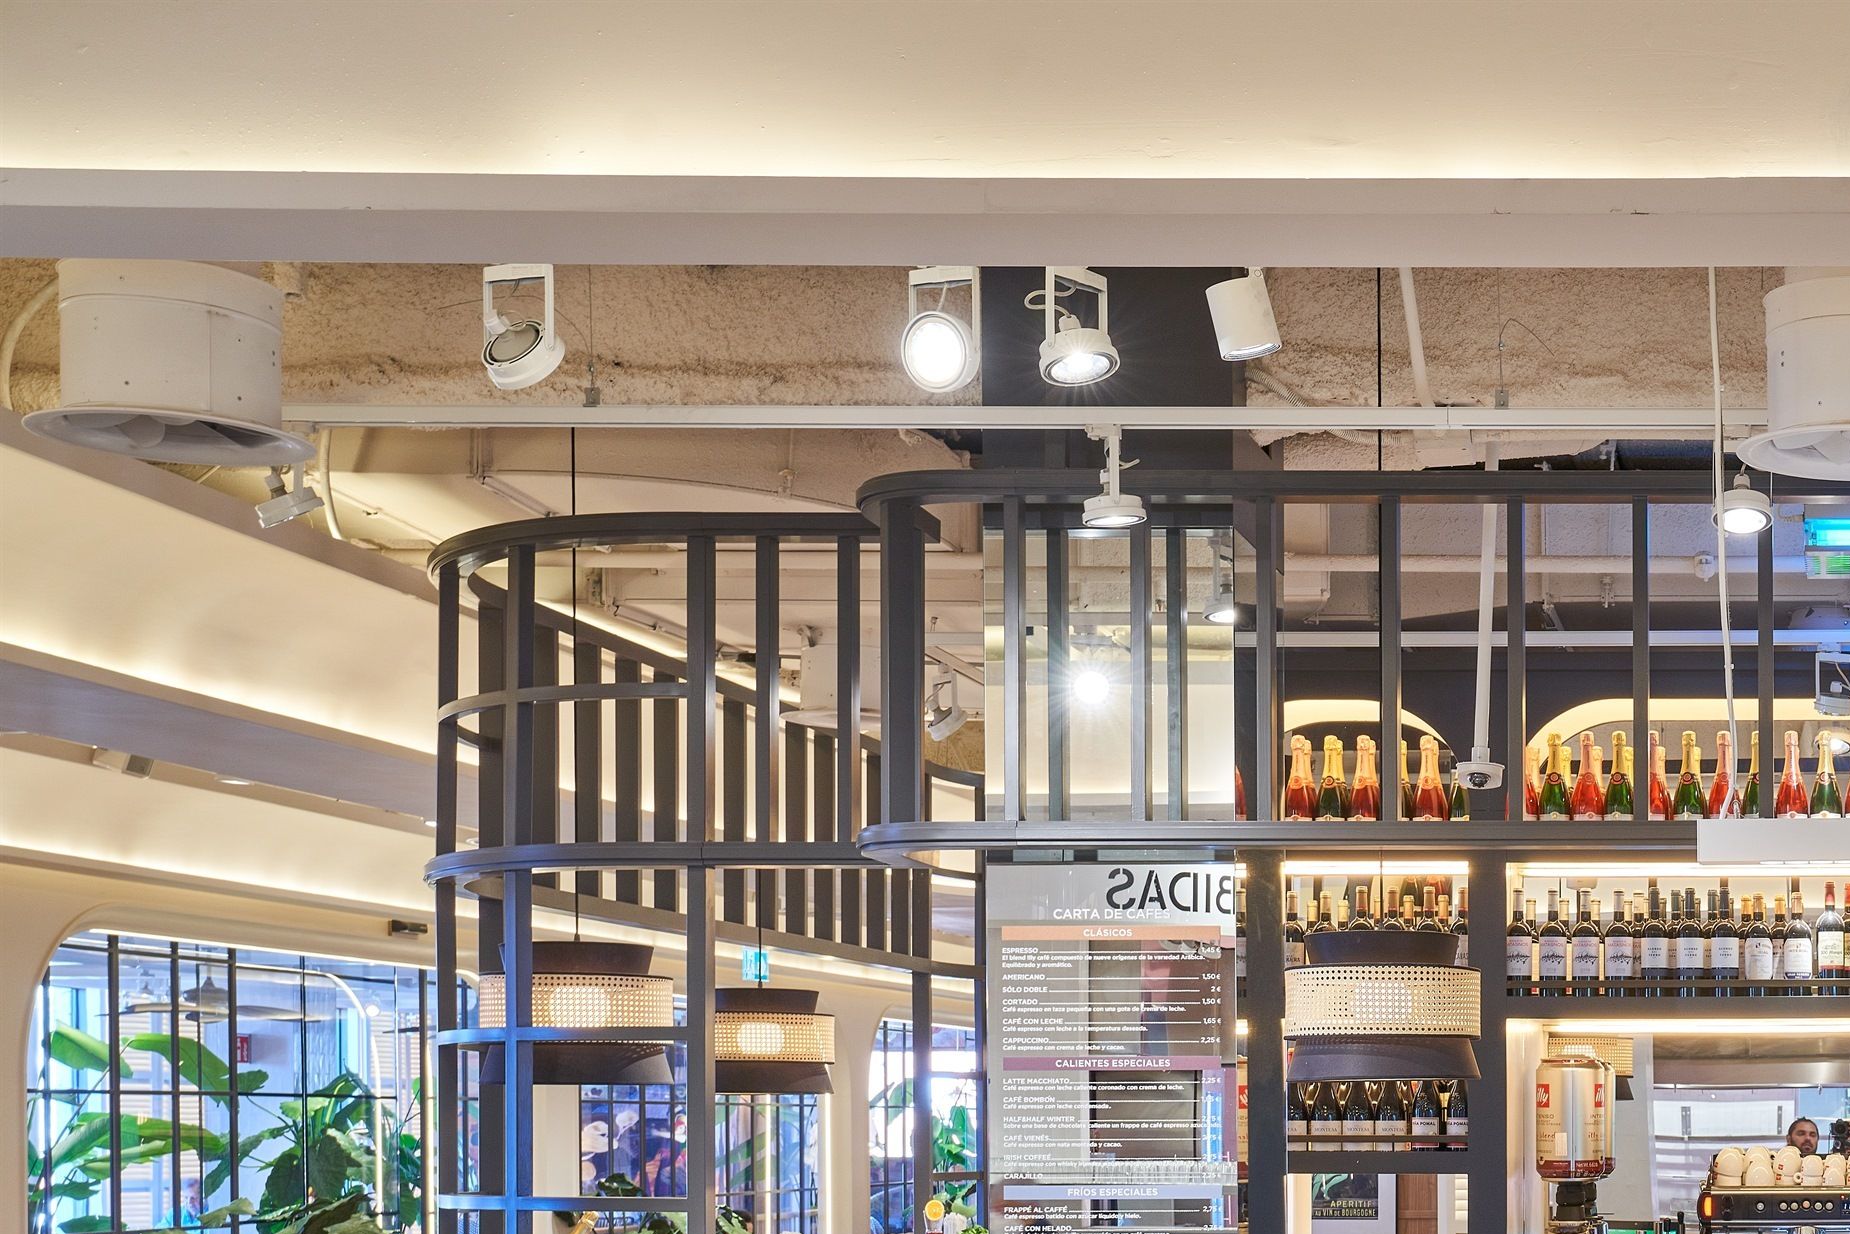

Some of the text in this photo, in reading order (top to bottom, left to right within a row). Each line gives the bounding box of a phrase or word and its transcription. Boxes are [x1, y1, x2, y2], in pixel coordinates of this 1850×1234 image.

[1054, 908, 1100, 920] CARTA
[1104, 908, 1122, 920] DE
[1083, 926, 1133, 938] CLÁSICOS
[1202, 946, 1214, 954] 1,45
[1002, 985, 1022, 993] SÓLO
[1024, 985, 1048, 993] DOBLE
[1055, 1059, 1170, 1067] CALIENTES ESPECIALES
[1003, 1095, 1022, 1103] CAFÉ
[1068, 1187, 1158, 1196] FRÍOS ESPECIALES
[1330, 1200, 1372, 1208] APERITIF
[1004, 1205, 1032, 1213] FRAPPÉ
[1033, 1205, 1043, 1213] AL
[1044, 1205, 1068, 1213] CAFFÉ
[1322, 1209, 1333, 1217] VIN
[1342, 1209, 1376, 1217] BOURGOGNE
